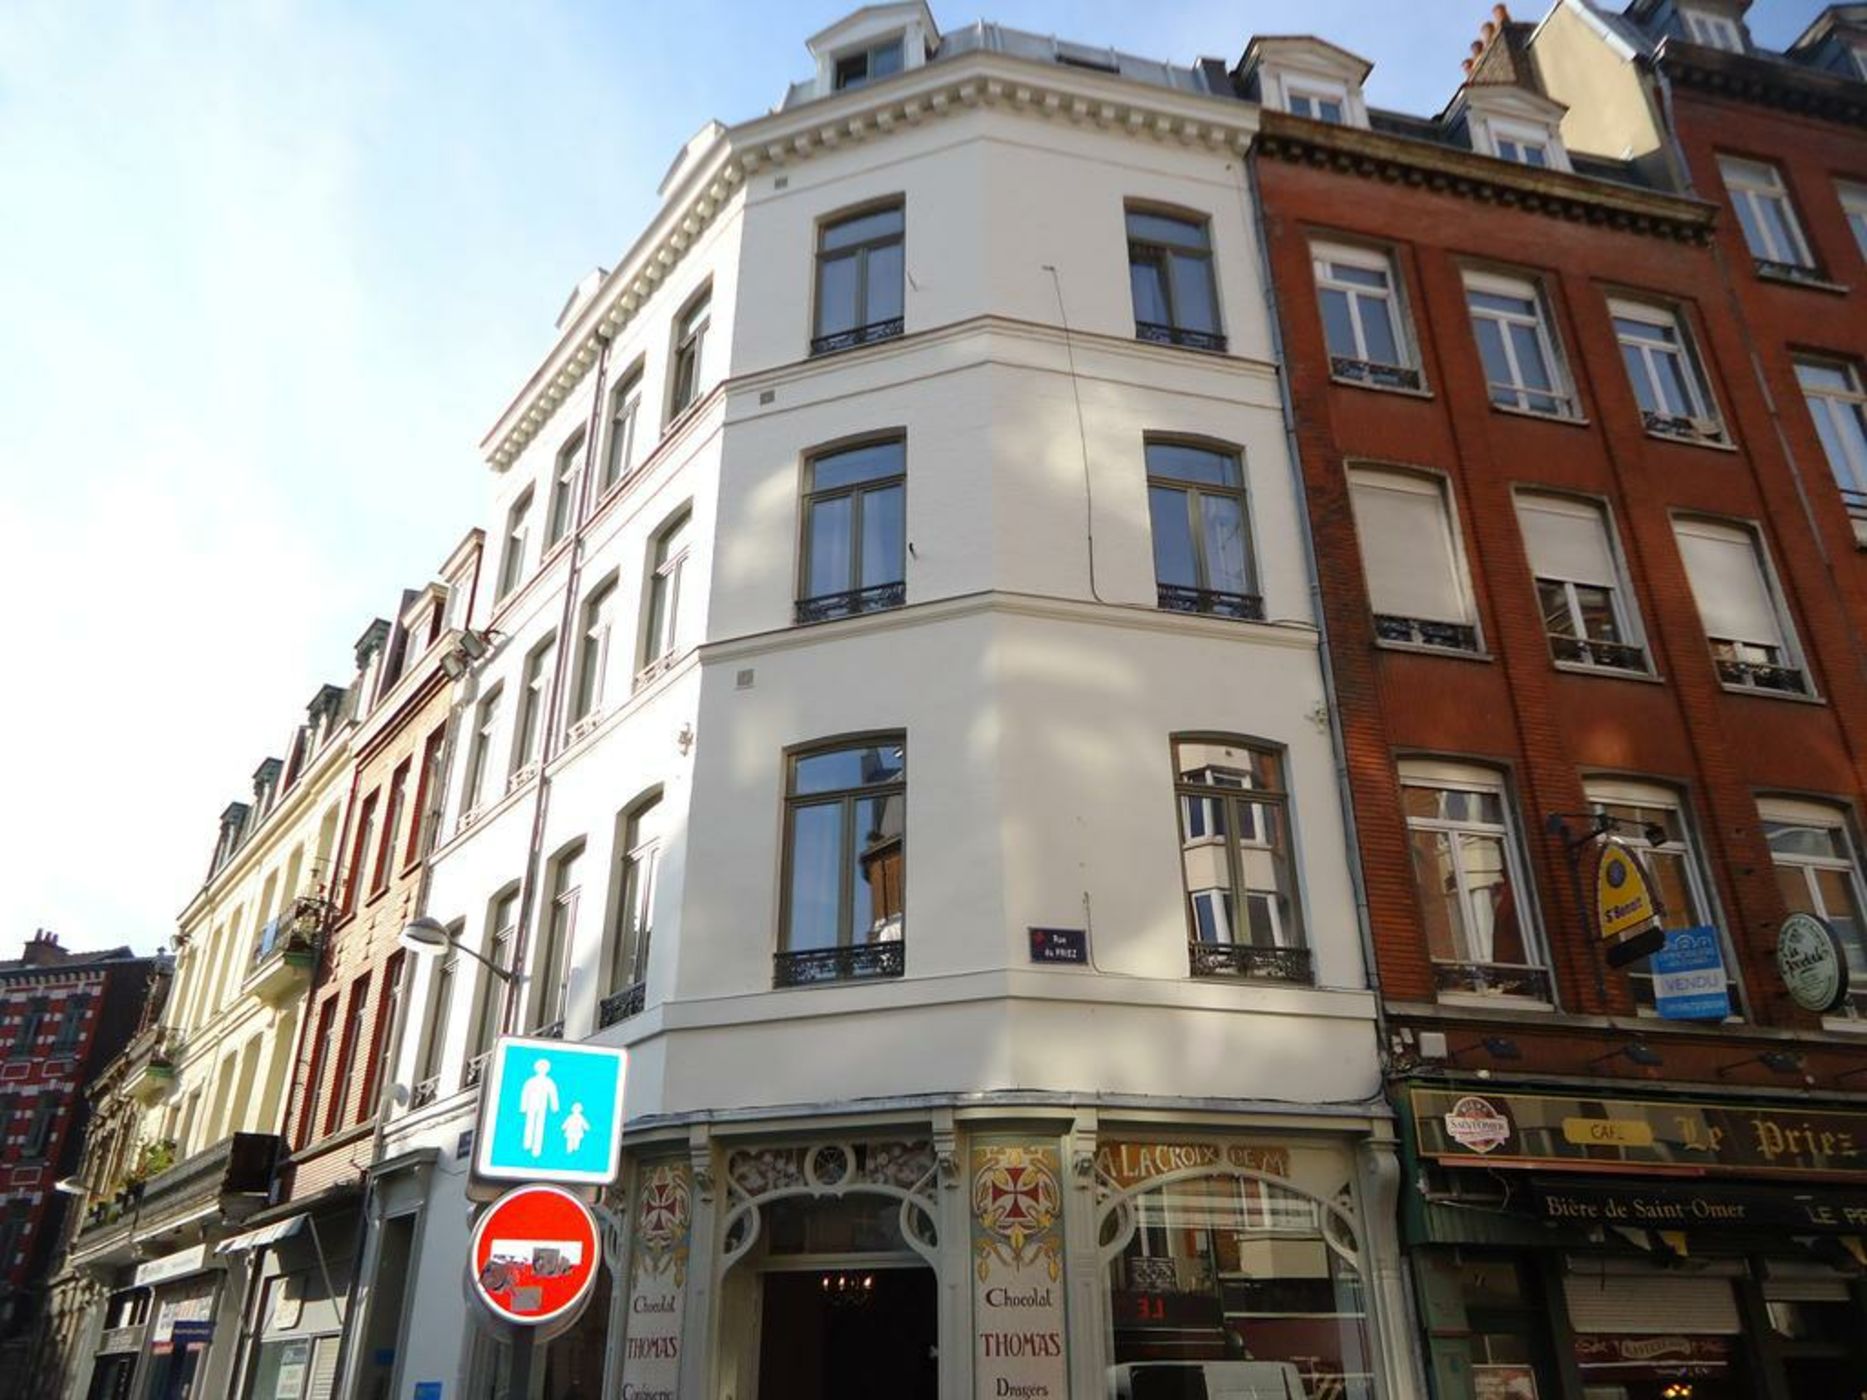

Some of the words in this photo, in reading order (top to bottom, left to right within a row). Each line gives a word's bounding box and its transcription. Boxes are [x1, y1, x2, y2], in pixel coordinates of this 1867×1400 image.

[1663, 975, 1720, 992] VENDU
[1674, 1116, 1724, 1151] Le
[1752, 1119, 1858, 1161] Priez
[1605, 1198, 1628, 1218] de
[627, 1335, 678, 1359] THOMAS
[980, 1332, 1061, 1357] THOMAS
